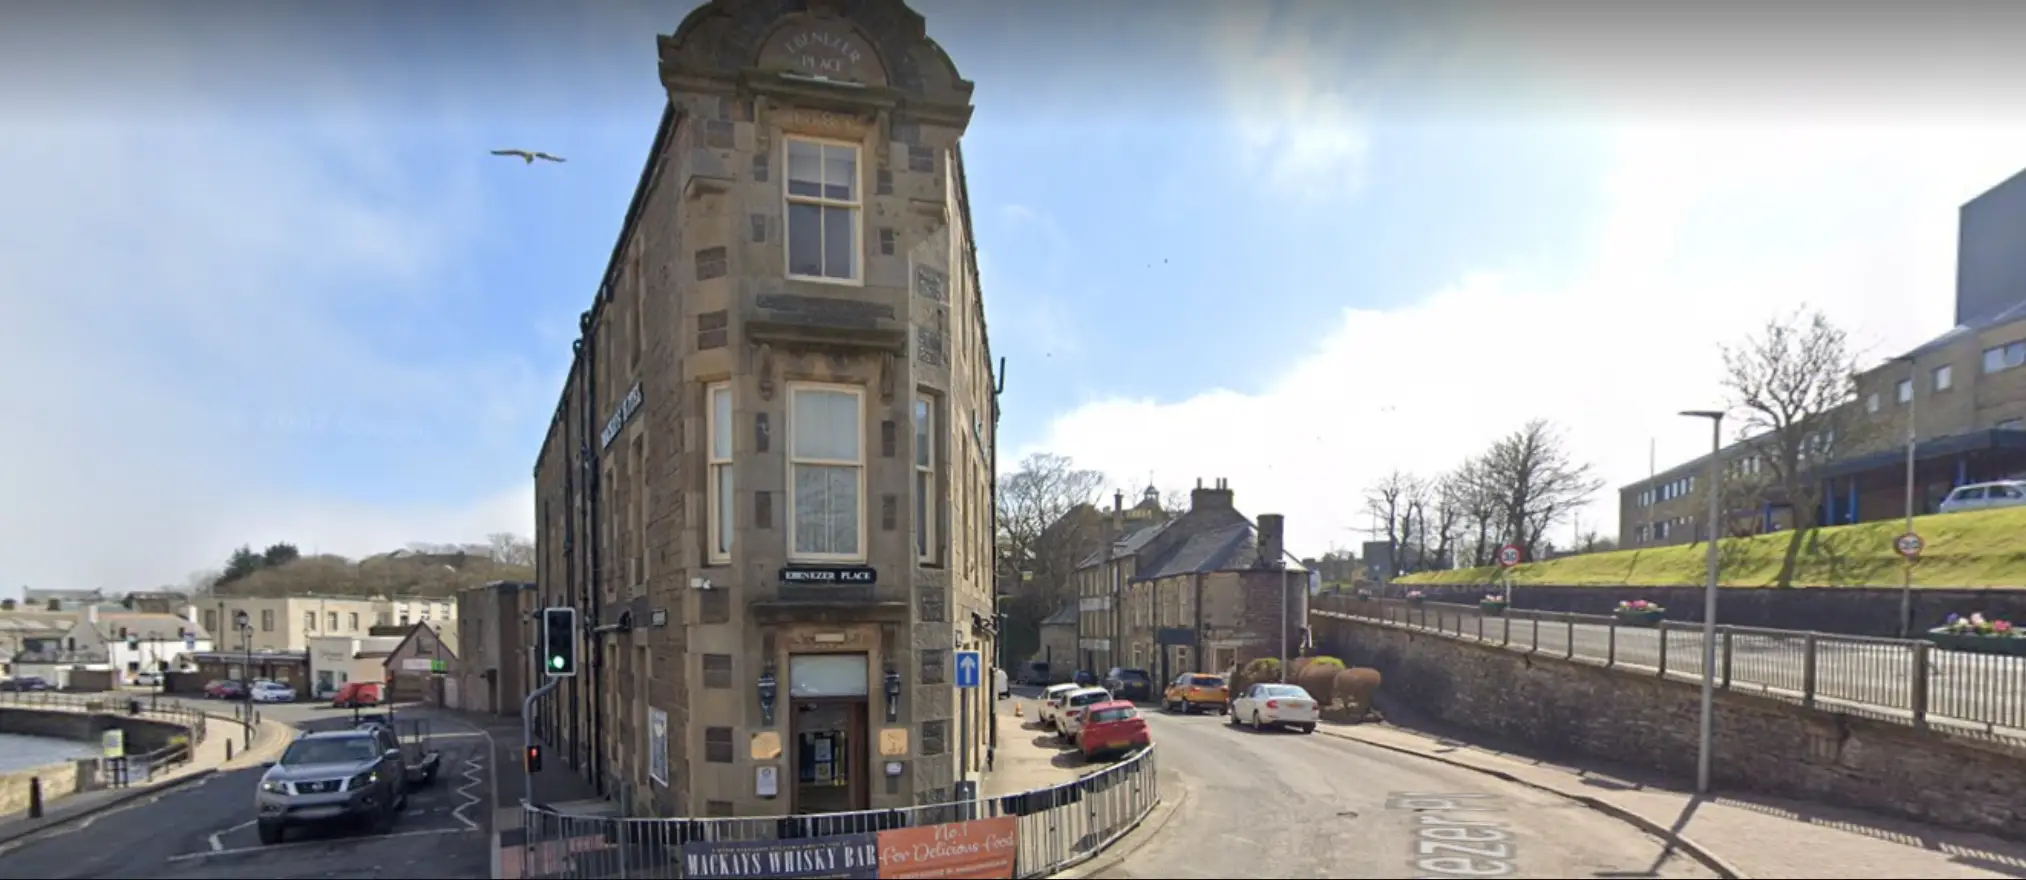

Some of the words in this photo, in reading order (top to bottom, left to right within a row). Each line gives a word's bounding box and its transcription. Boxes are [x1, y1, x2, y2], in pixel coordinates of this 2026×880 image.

[783, 31, 861, 65] EBENEZER
[785, 571, 836, 580] EBENEZER
[841, 571, 871, 580] PLACE
[687, 852, 762, 877] MACKAYS
[768, 847, 836, 874] WHISKY
[844, 844, 877, 869] BAR
[879, 845, 911, 866] for
[912, 840, 980, 863] Delicious
